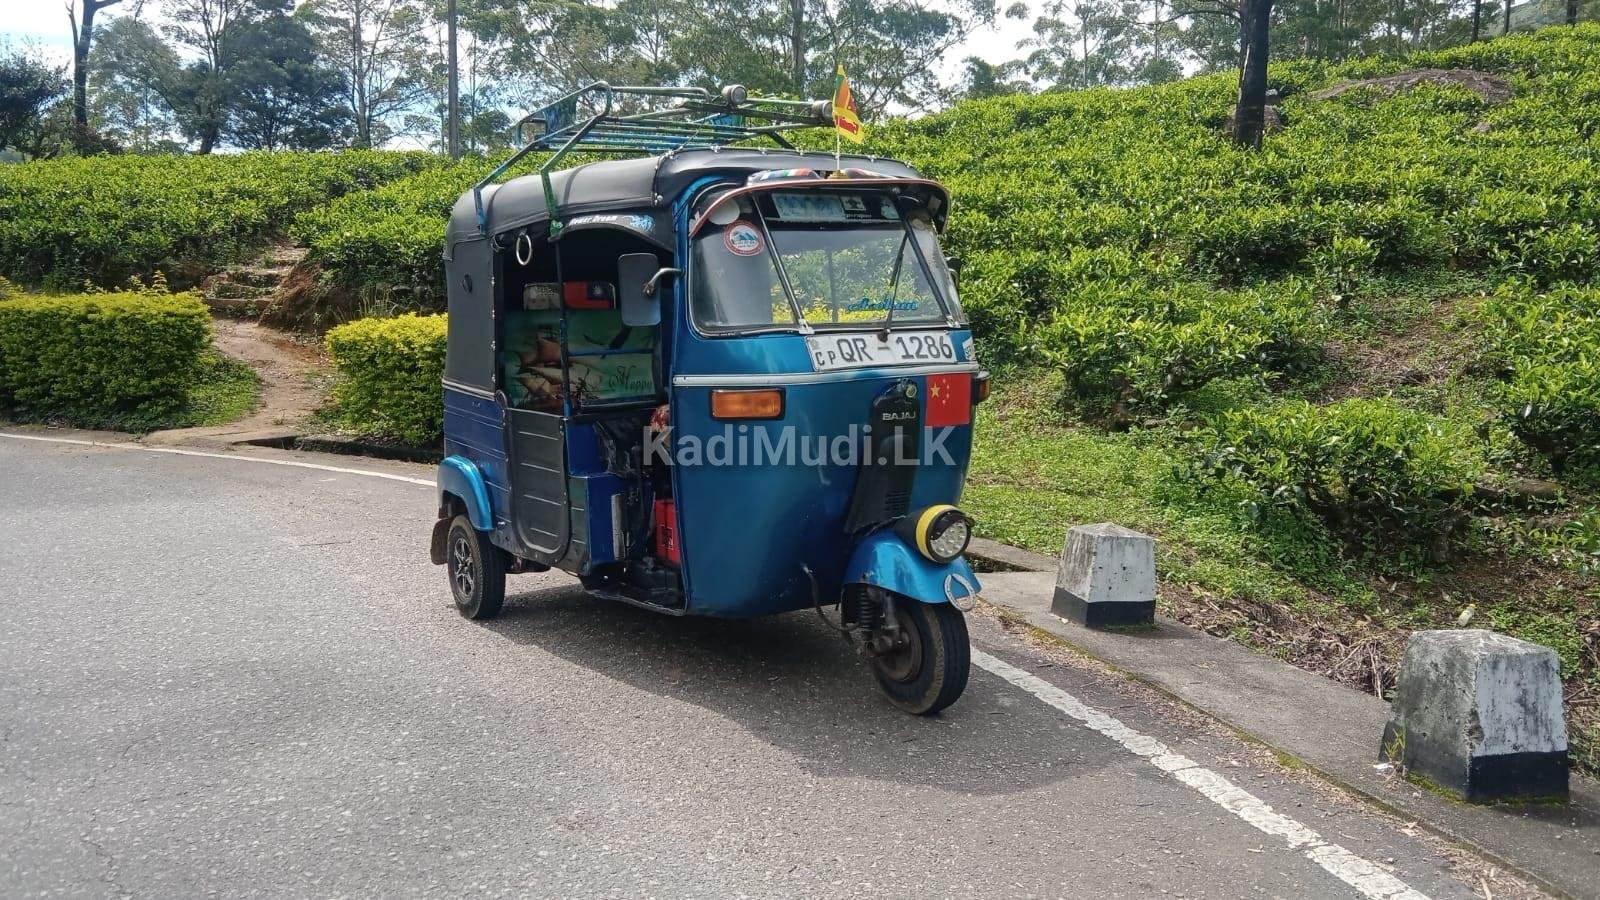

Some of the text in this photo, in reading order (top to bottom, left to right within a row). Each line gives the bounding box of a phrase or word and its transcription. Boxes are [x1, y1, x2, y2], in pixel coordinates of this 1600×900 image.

[836, 338, 873, 362] QR
[895, 335, 953, 360] 1286
[882, 411, 916, 421] BAJAJ
